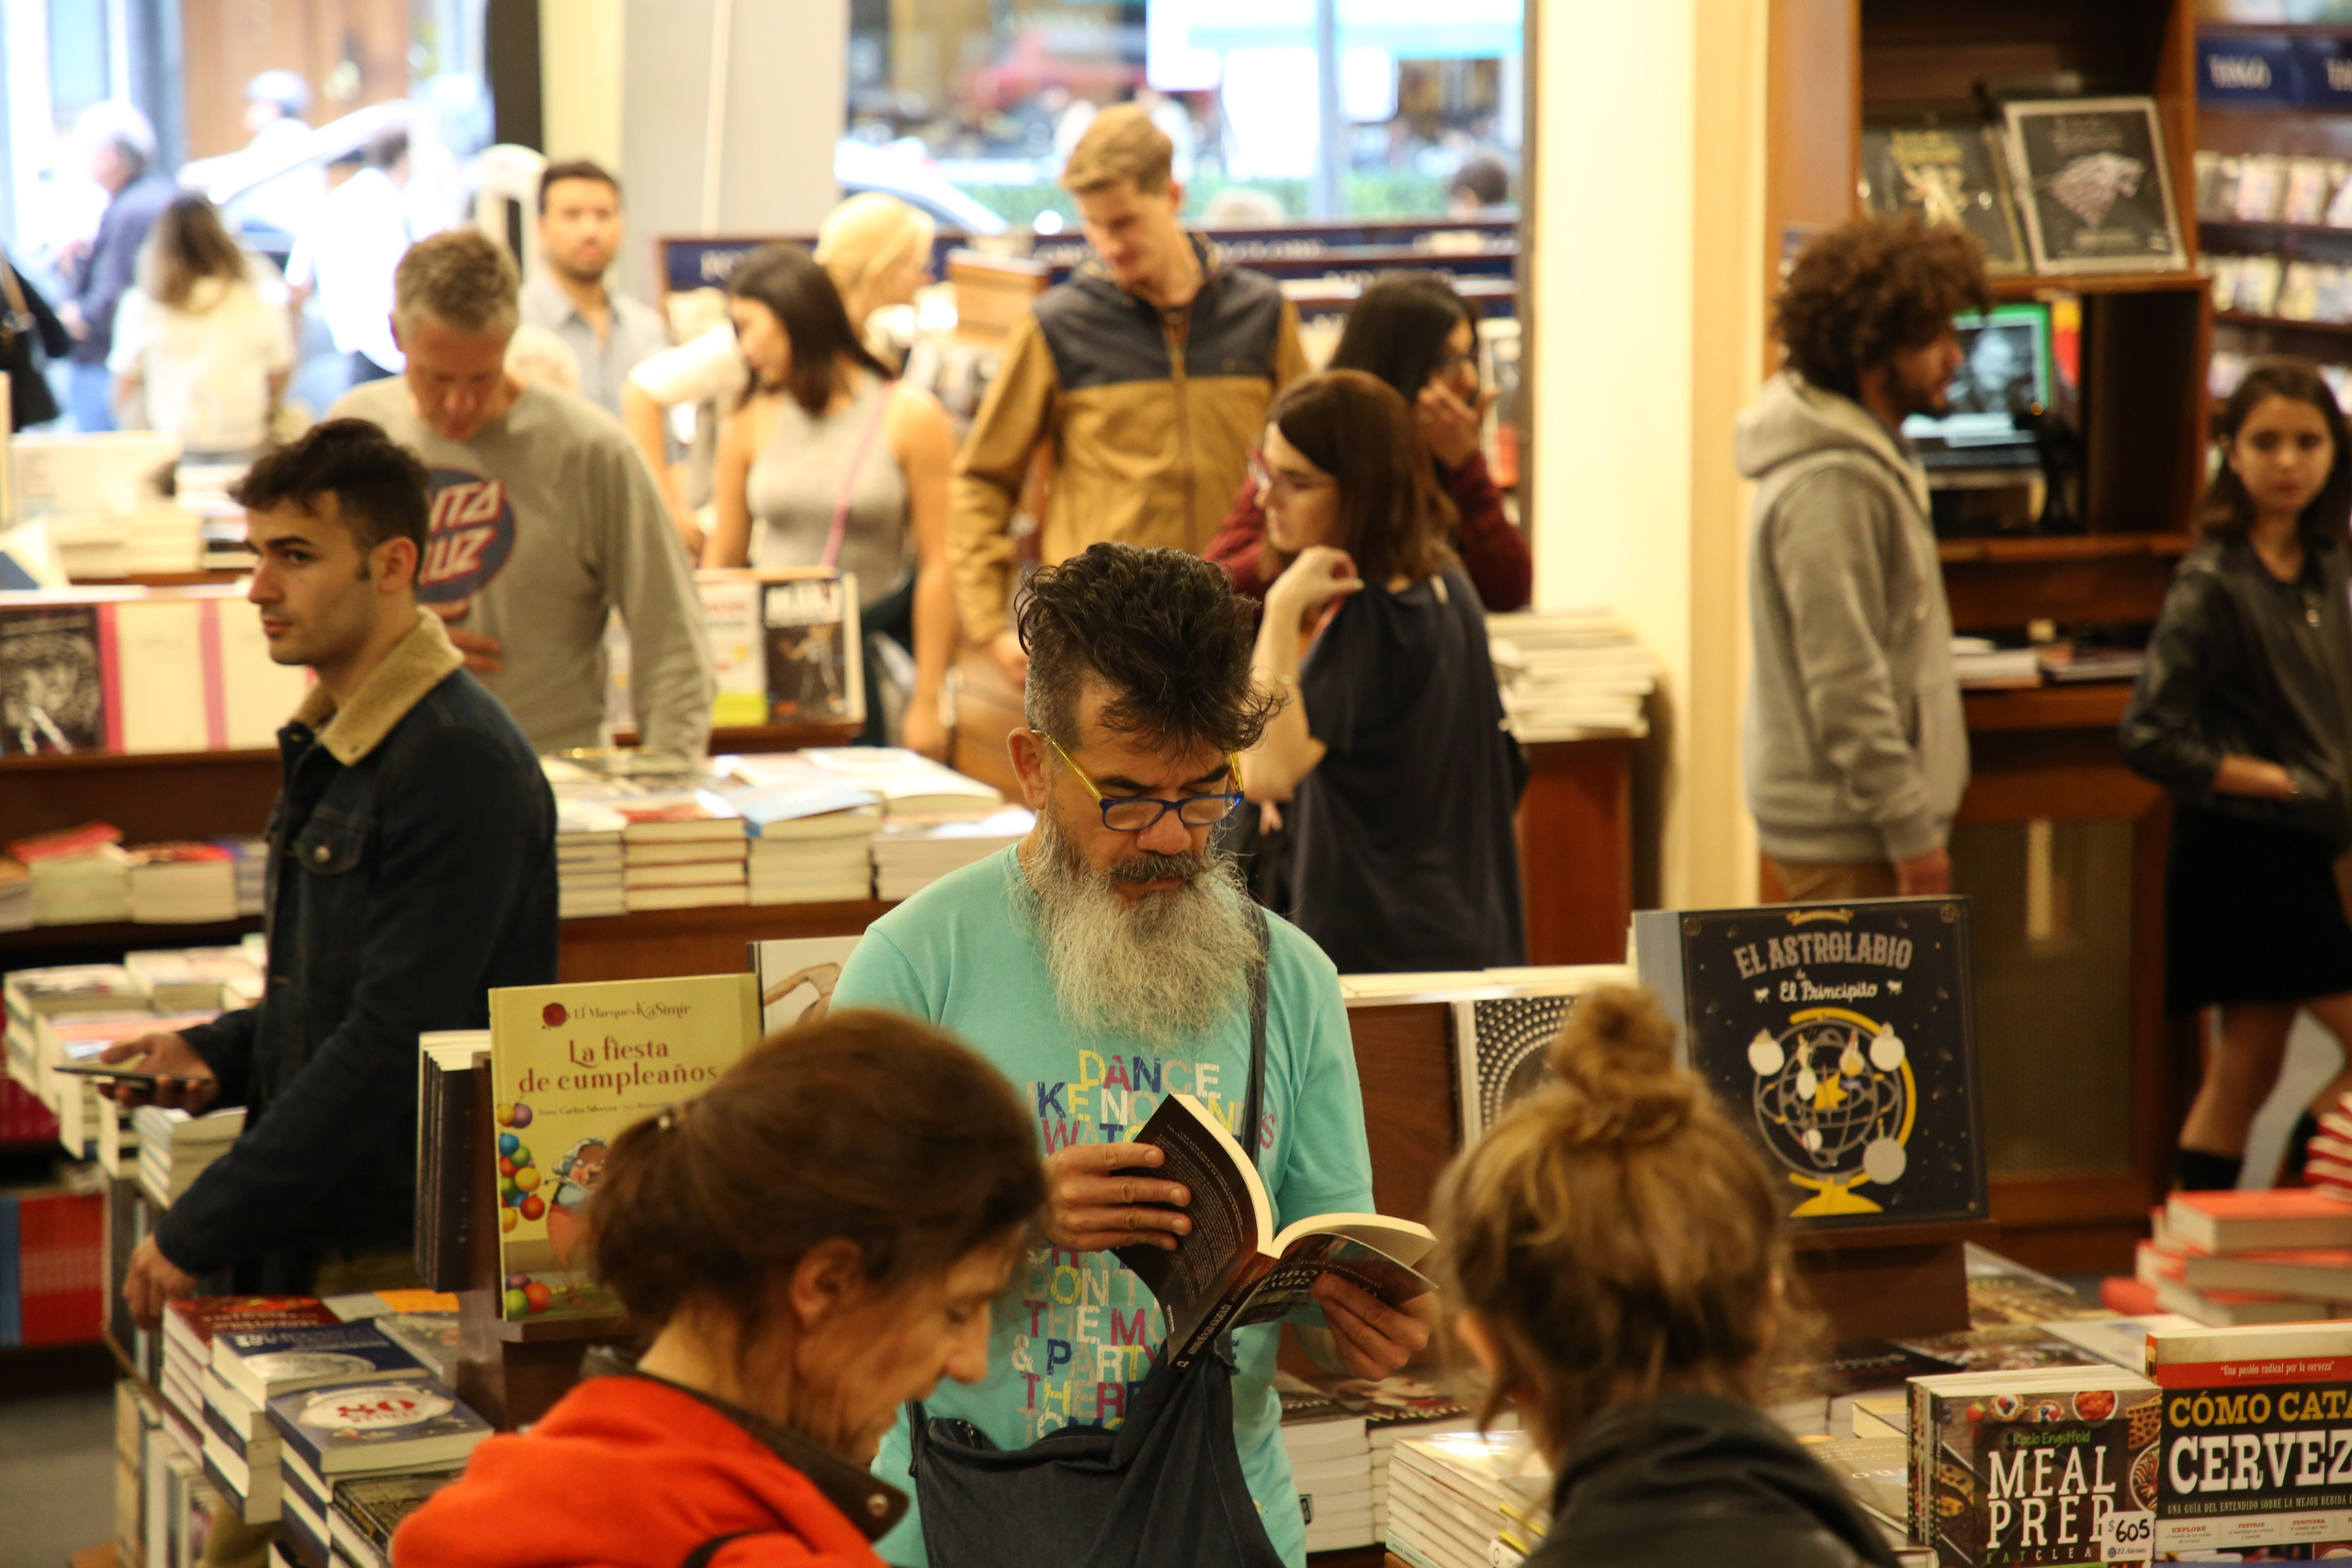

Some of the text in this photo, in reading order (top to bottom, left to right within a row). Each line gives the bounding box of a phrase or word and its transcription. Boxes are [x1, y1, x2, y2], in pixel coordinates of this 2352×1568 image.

[1733, 931, 1913, 980] EL ASTROLABIO
[1779, 979, 1879, 1003] El Principito
[570, 1035, 668, 1069] La fiesta
[519, 1062, 718, 1095] de cumpleaños
[1079, 1049, 1221, 1100] DANCE
[1026, 1080, 1091, 1122] IKE
[1023, 1300, 1101, 1344] THE
[1012, 1333, 1035, 1373] &
[2239, 1364, 2259, 1377] pasión
[2261, 1362, 2284, 1374] radical
[2286, 1363, 2297, 1375] por
[2299, 1361, 2305, 1372] la
[2168, 1391, 2271, 1427] CÓMO
[1987, 1446, 2116, 1500] MEAL
[2168, 1429, 2352, 1495] CERVEZ
[2167, 1495, 2346, 1515] UNA GUÍA DEL ENTENDIDO SOBRE LA MEJOR BEBIDA
[2171, 1526, 2207, 1534] EXPLORE
[2036, 1547, 2092, 1561] CLEA
